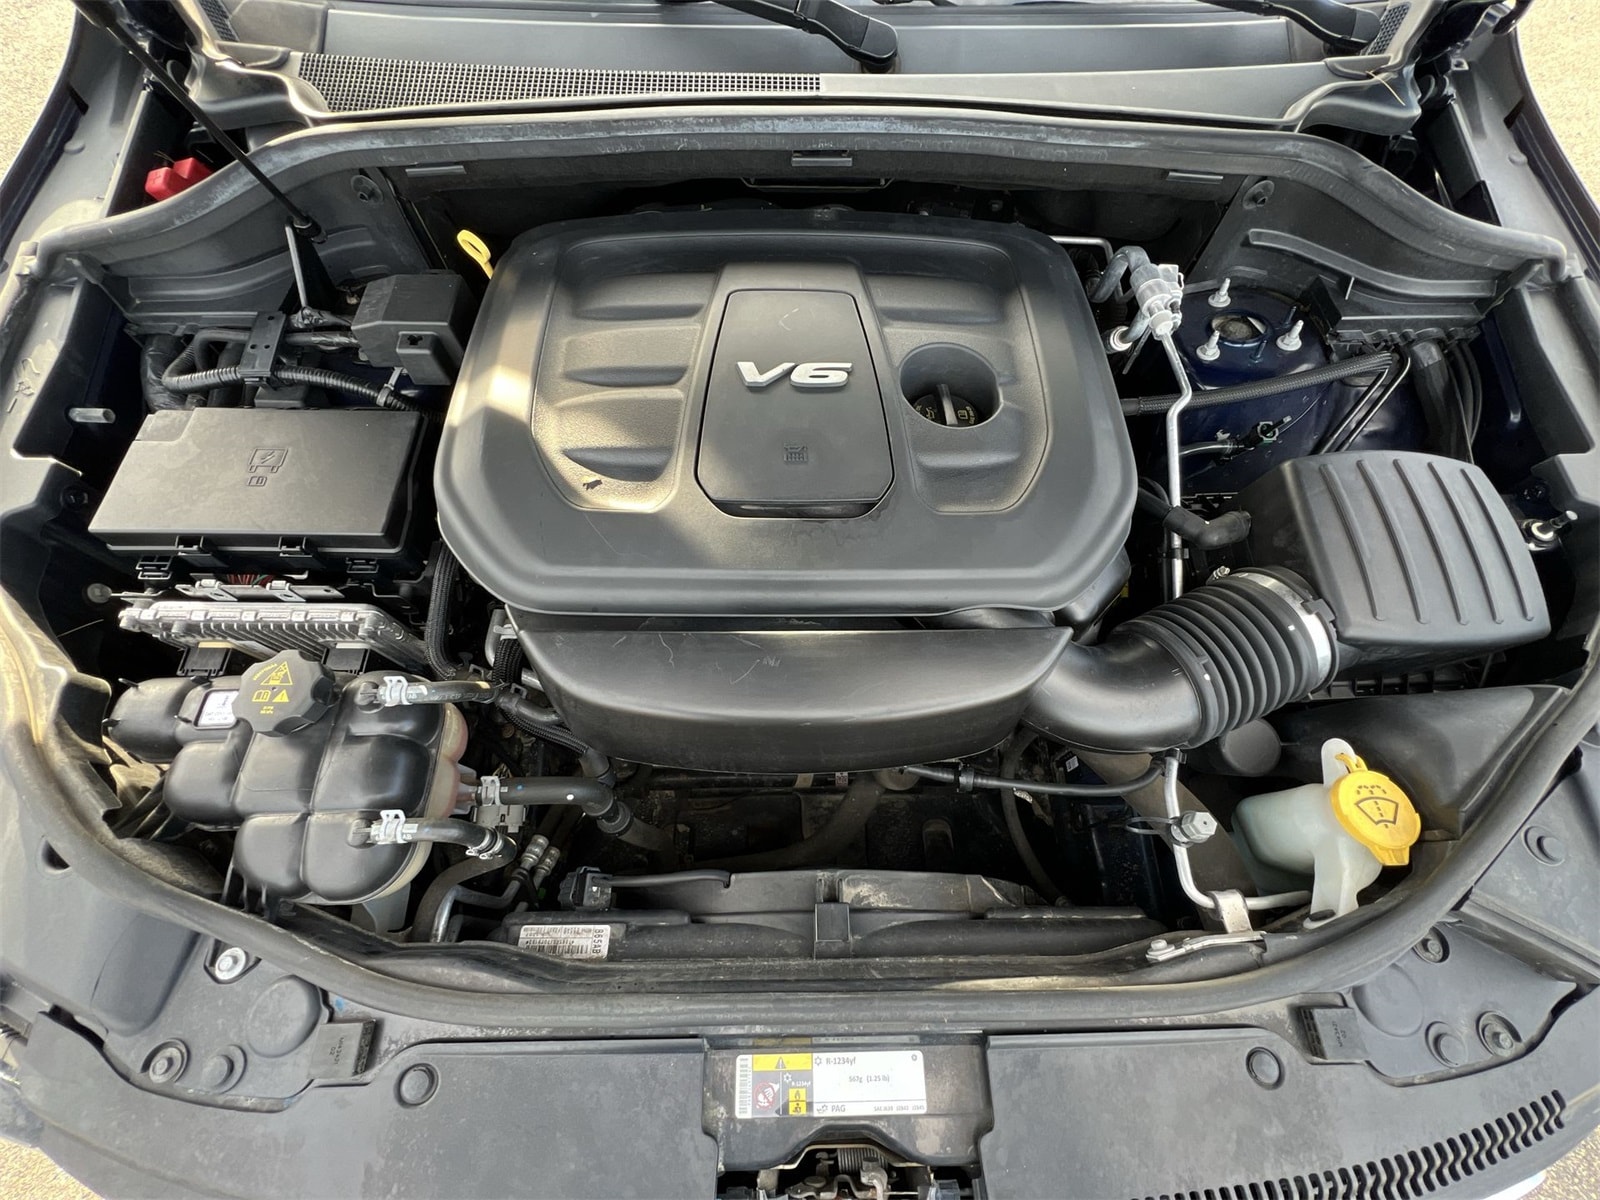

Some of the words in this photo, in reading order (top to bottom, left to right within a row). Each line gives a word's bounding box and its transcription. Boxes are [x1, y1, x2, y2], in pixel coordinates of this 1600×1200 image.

[736, 361, 853, 389] V6
[592, 928, 604, 954] 865AB
[826, 1056, 856, 1066] R-1234yf
[831, 1105, 846, 1113] PAG
